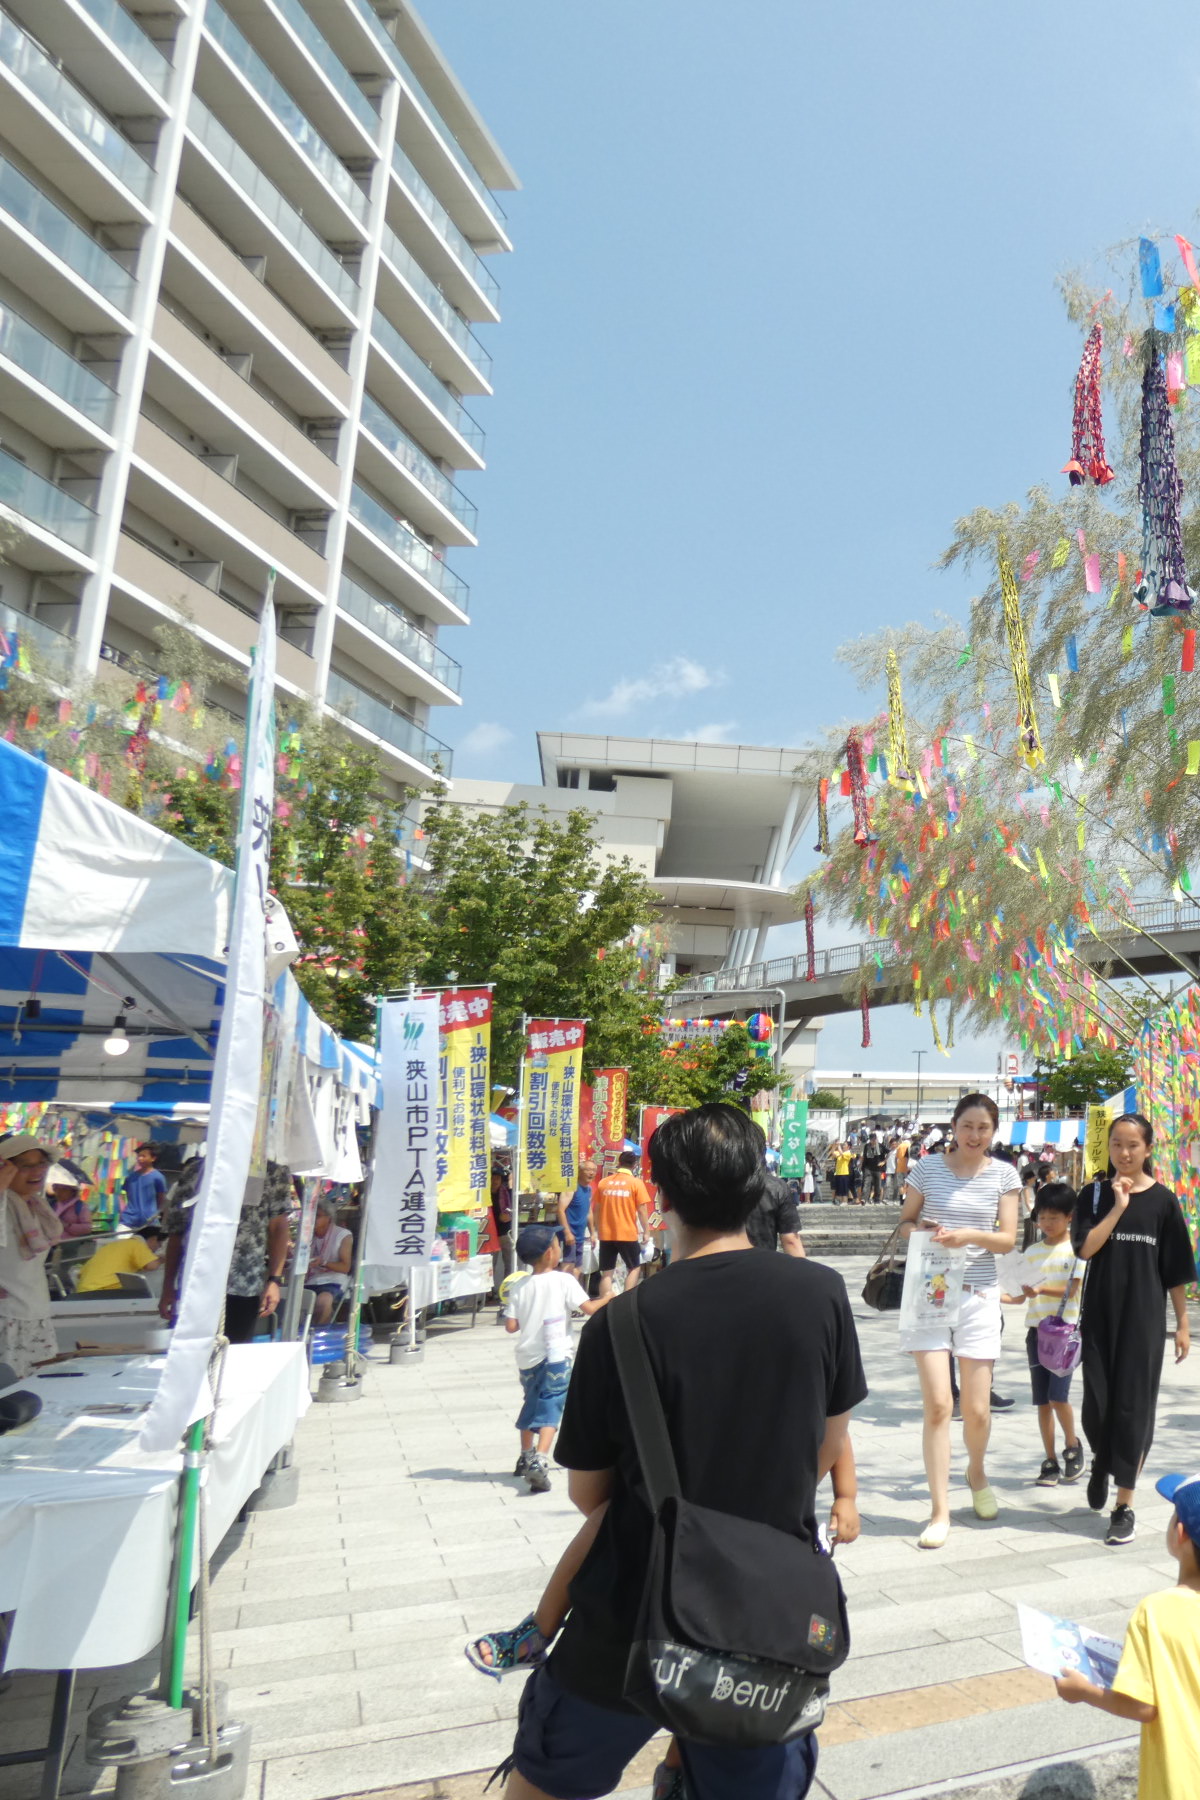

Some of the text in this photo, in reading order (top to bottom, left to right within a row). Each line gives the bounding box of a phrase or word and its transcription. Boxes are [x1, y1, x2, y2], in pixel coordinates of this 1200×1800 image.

[531, 1027, 581, 1049] 販売中
[452, 1066, 465, 1138] 便利でお得な
[527, 1071, 549, 1170] 割引回数券
[549, 1081, 560, 1137] 便利でお得な
[393, 1059, 429, 1256] 狭山市PTA連合会
[786, 1121, 801, 1166] つなん
[1116, 1232, 1157, 1246] SOMEWHERE
[711, 1666, 791, 1712] beruf
